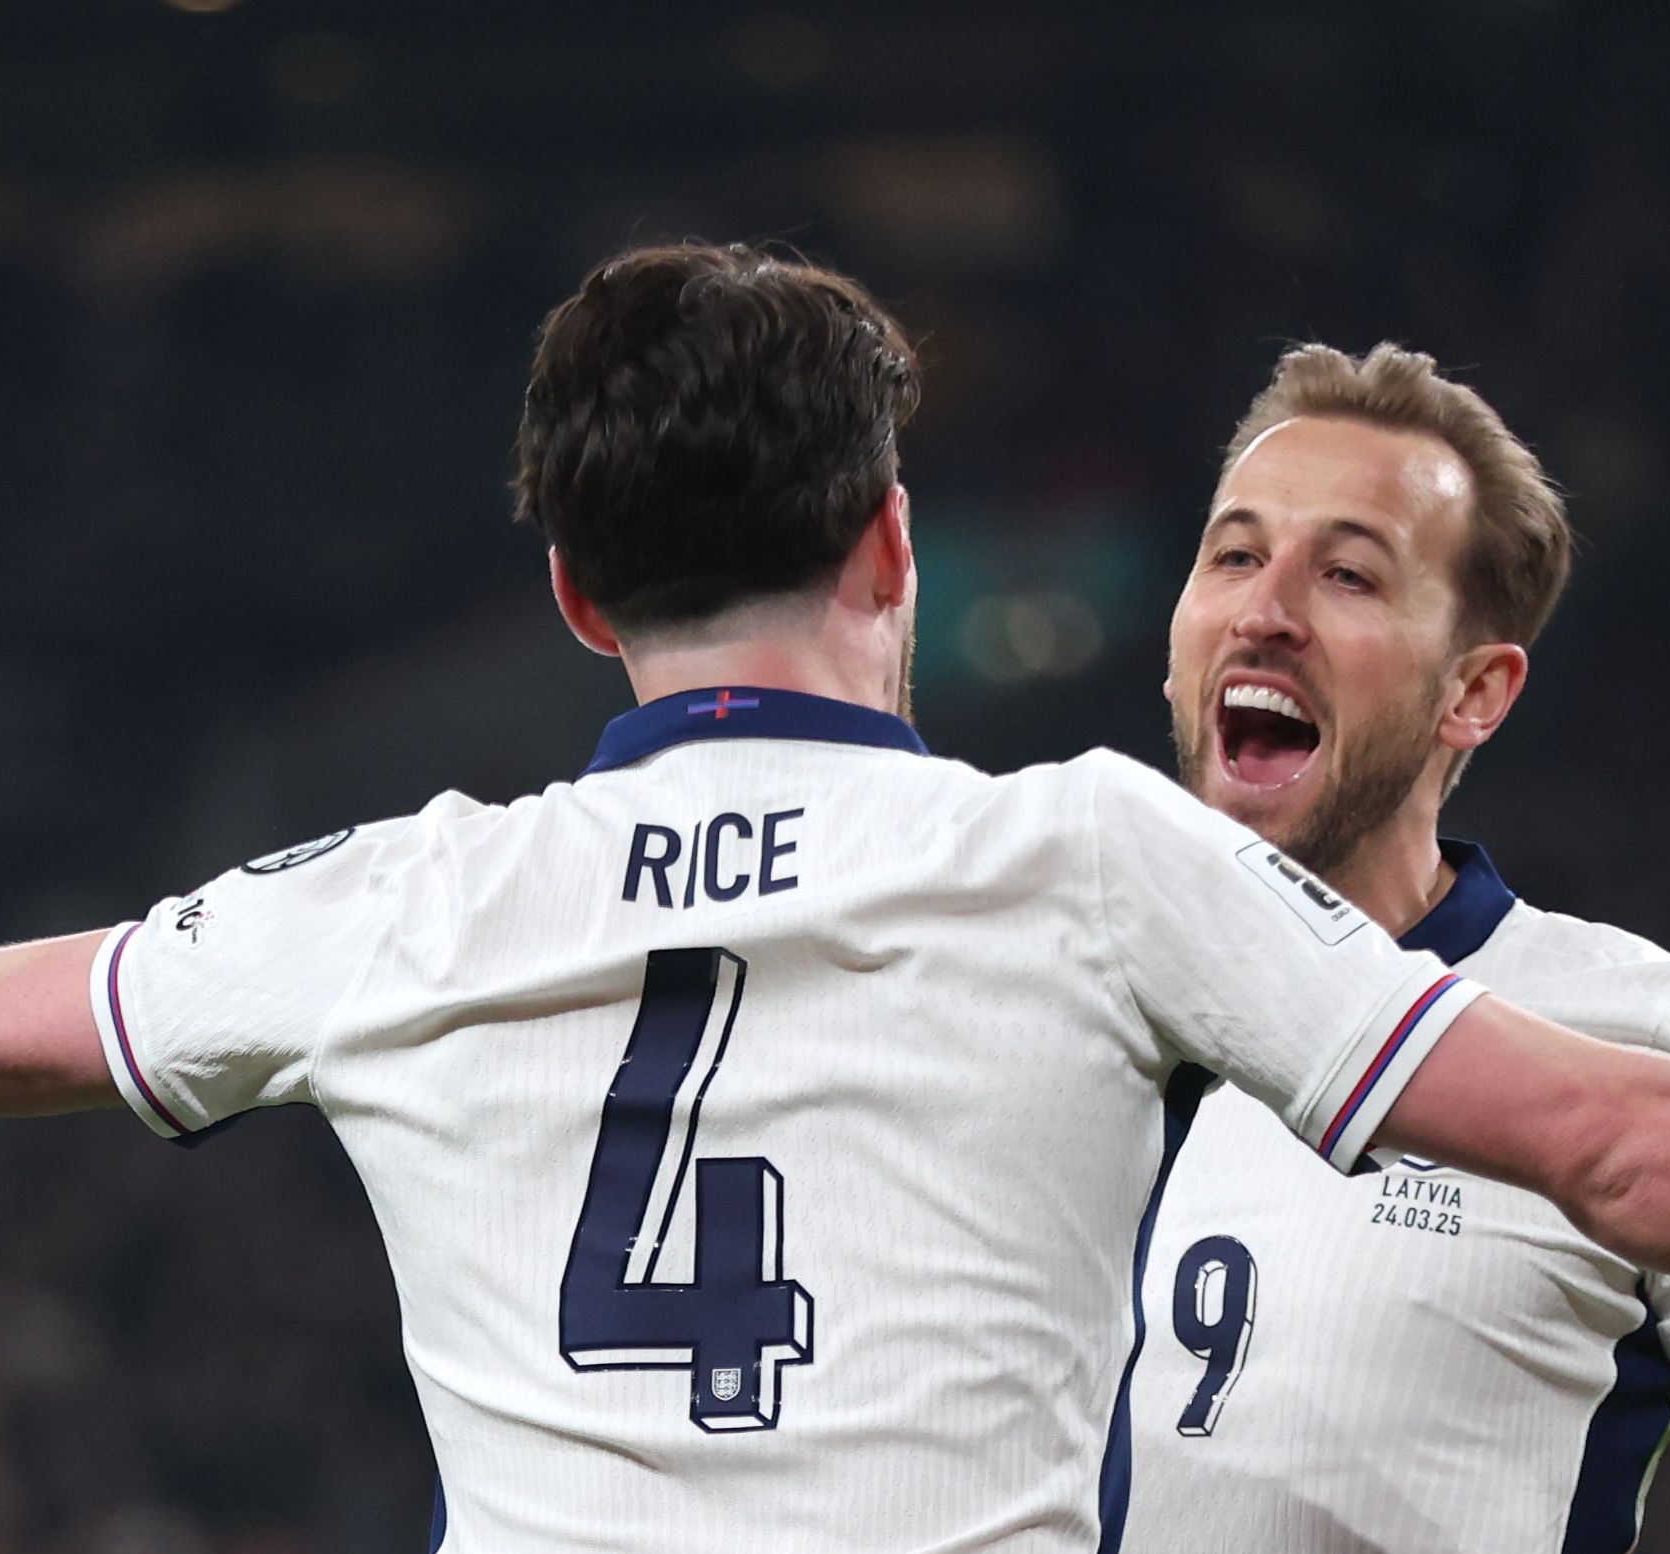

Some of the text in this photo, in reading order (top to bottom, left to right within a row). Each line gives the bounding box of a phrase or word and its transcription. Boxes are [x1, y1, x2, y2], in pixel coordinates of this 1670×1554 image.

[621, 807, 806, 910] RICE
[559, 946, 814, 1435] 4
[1370, 1203, 1463, 1237] 24.03.25
[1382, 1175, 1462, 1209] LATVIA
[1172, 1234, 1259, 1438] 9
